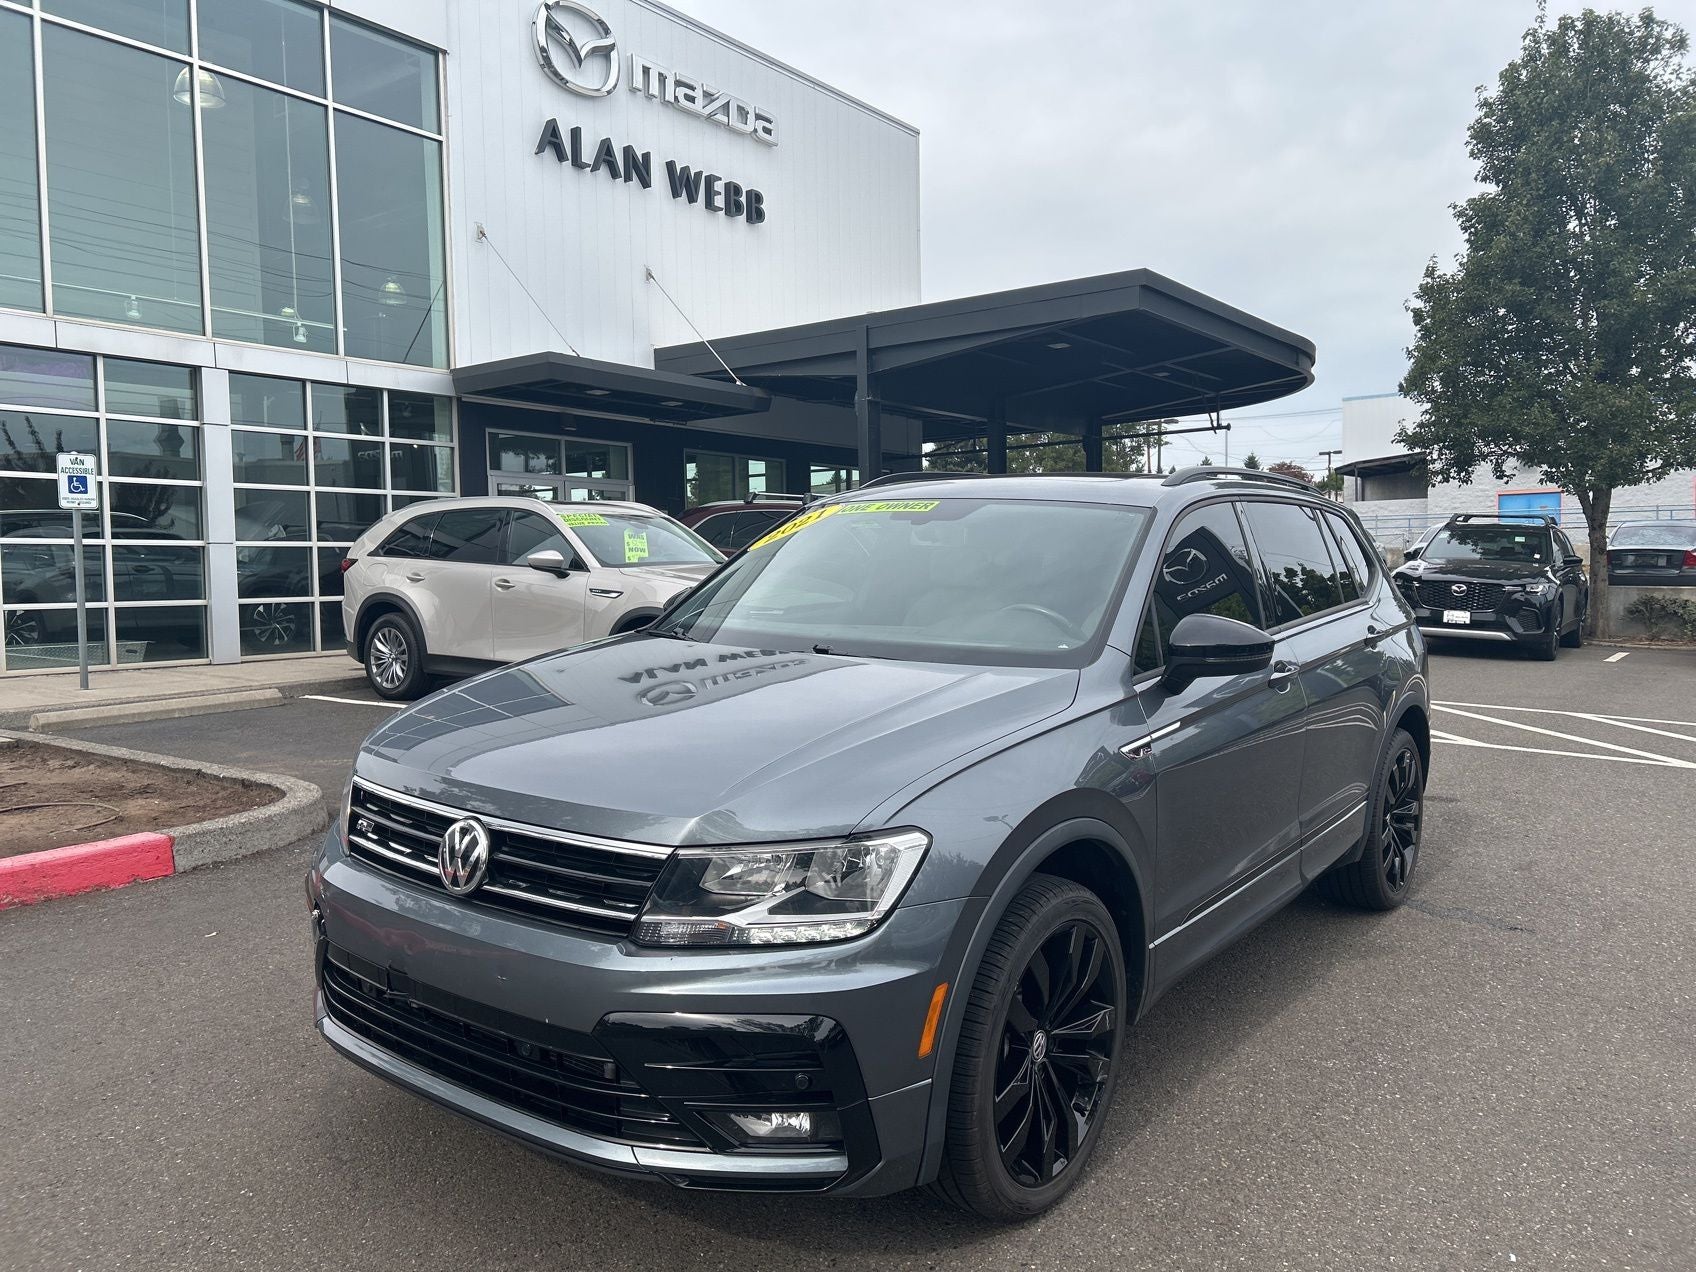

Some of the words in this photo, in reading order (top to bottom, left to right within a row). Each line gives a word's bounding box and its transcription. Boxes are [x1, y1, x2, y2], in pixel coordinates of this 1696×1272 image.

[534, 117, 652, 189] ALAN
[665, 159, 766, 224] WEBB
[69, 458, 85, 466] VAN
[60, 466, 95, 475] ACCESSIBLE
[842, 503, 874, 514] ONE
[877, 501, 935, 512] OWNER
[763, 509, 828, 544] 2021
